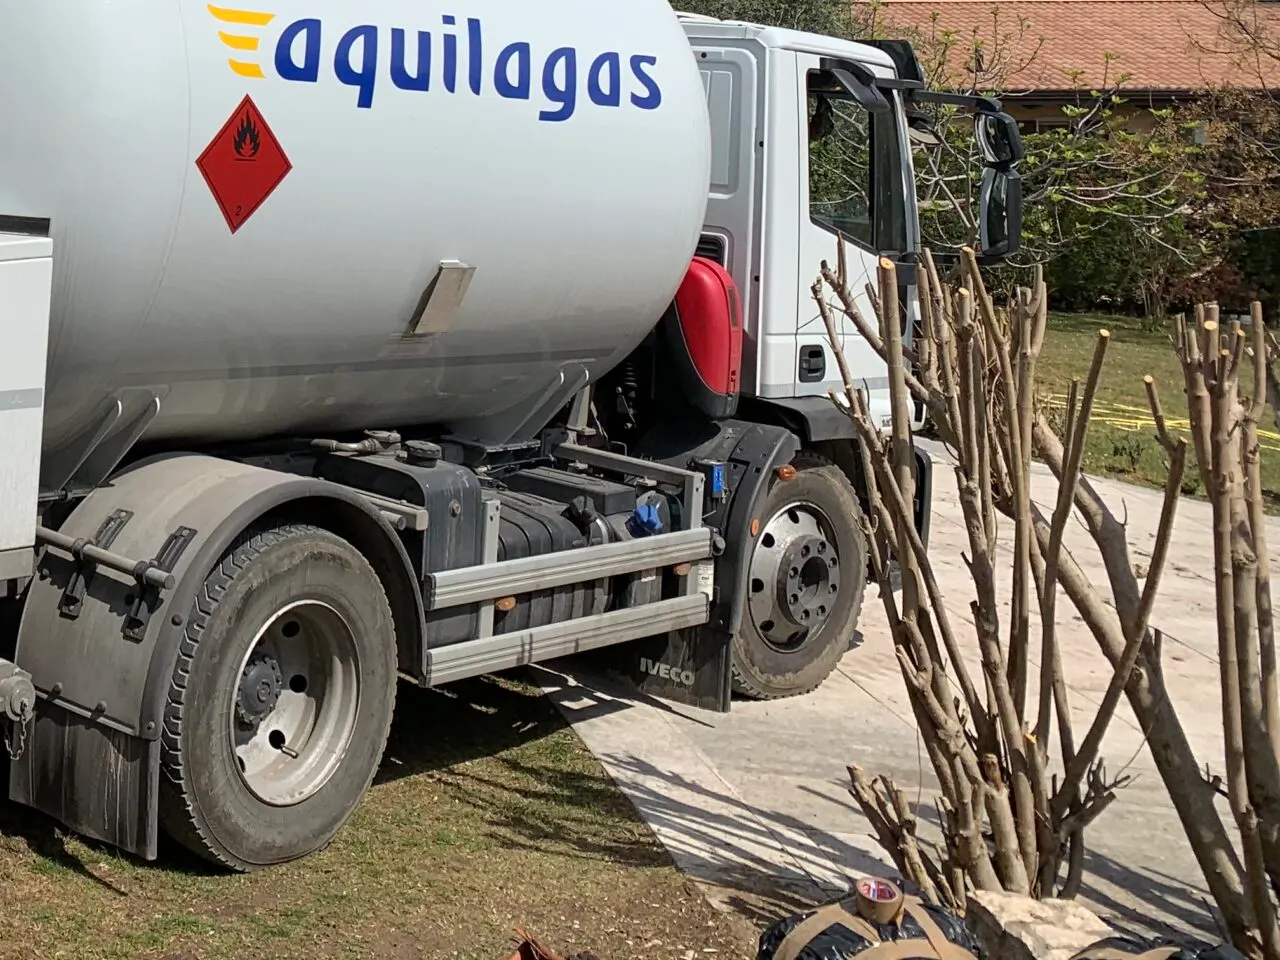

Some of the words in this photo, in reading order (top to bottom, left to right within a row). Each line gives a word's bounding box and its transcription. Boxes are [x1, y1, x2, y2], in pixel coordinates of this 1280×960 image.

[274, 14, 662, 122] aquilagas
[234, 205, 242, 217] 2
[639, 657, 695, 685] IVECO
